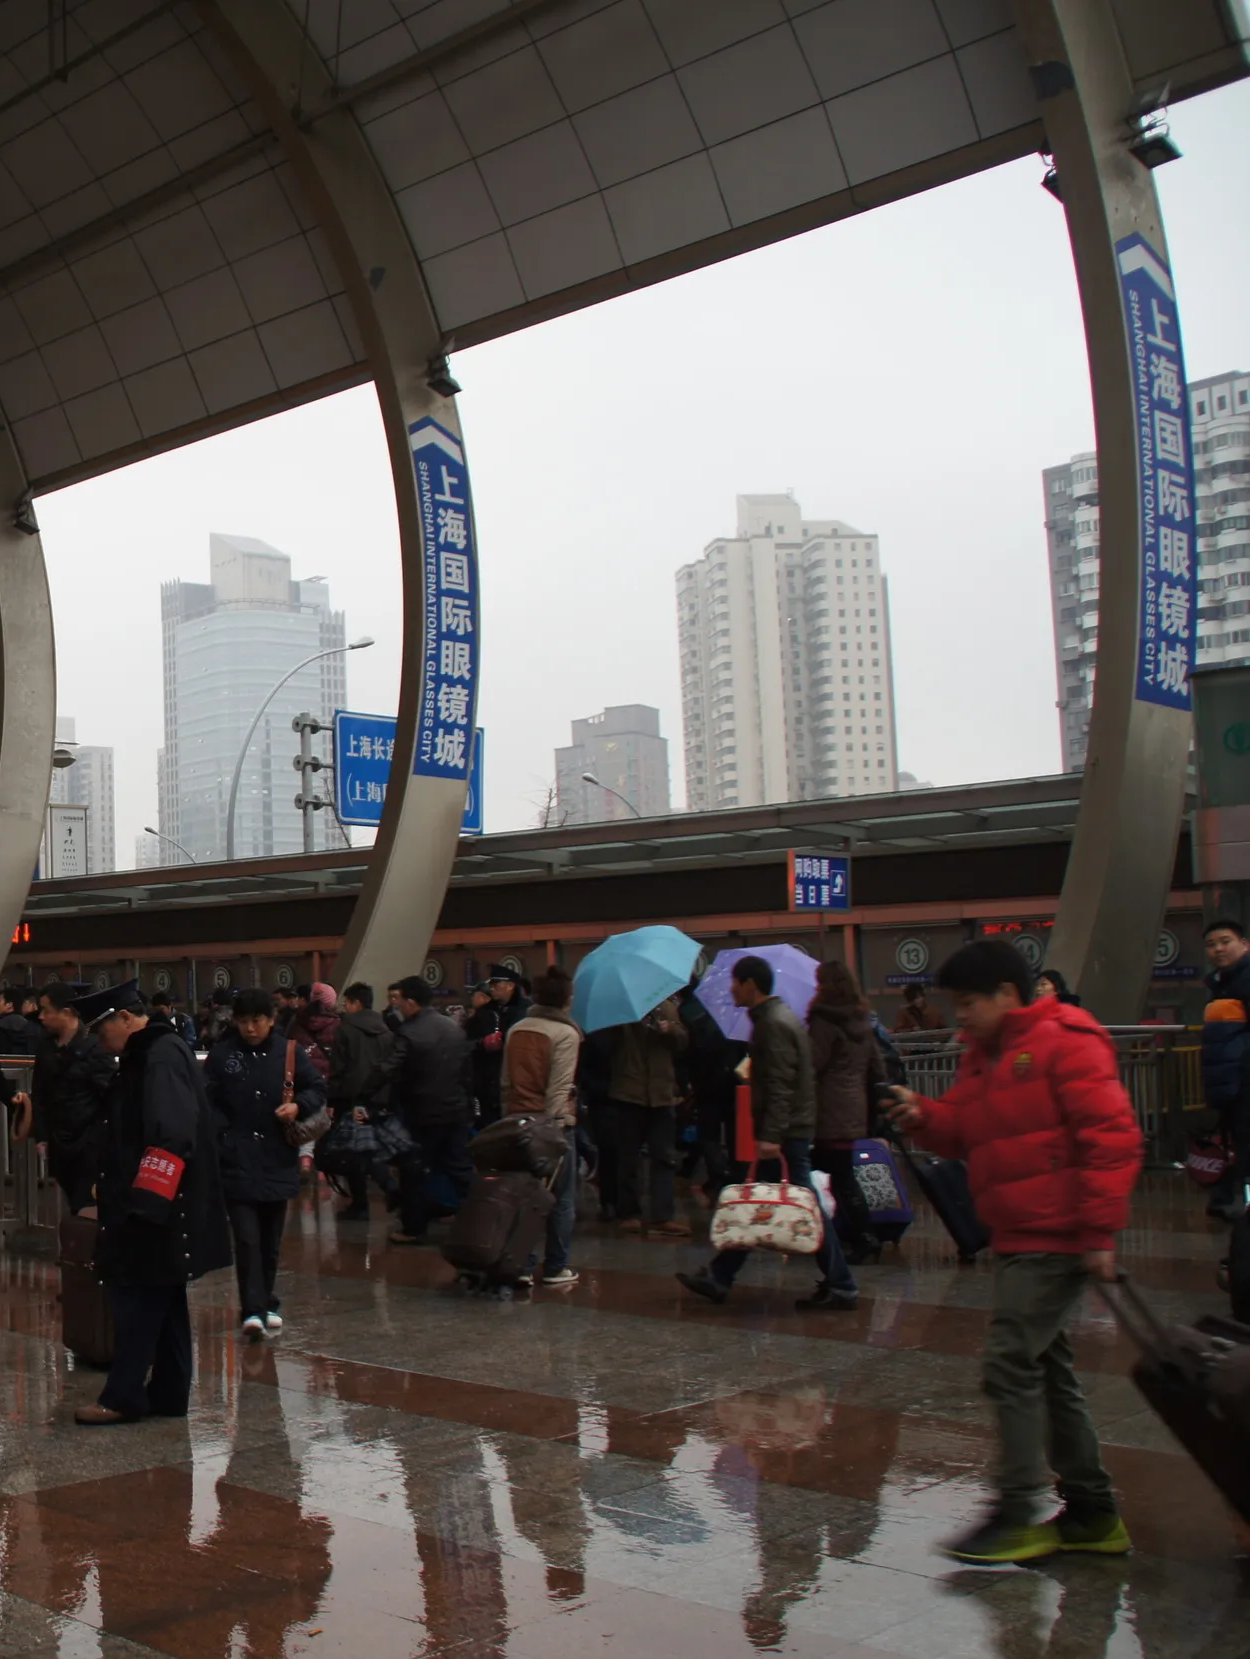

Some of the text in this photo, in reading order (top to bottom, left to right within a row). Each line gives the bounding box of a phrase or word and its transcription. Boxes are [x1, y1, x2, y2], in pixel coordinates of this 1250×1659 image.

[418, 461, 438, 764] SHANGHAI INTERNATIONAL GLASSES CITY
[434, 464, 474, 769] 上海国际眼镜城
[1128, 288, 1157, 686] SHANGHAI INTERNATIONAL GLASSES CITY
[1147, 297, 1191, 697] 上海国际眼镜城
[904, 947, 921, 965] 13
